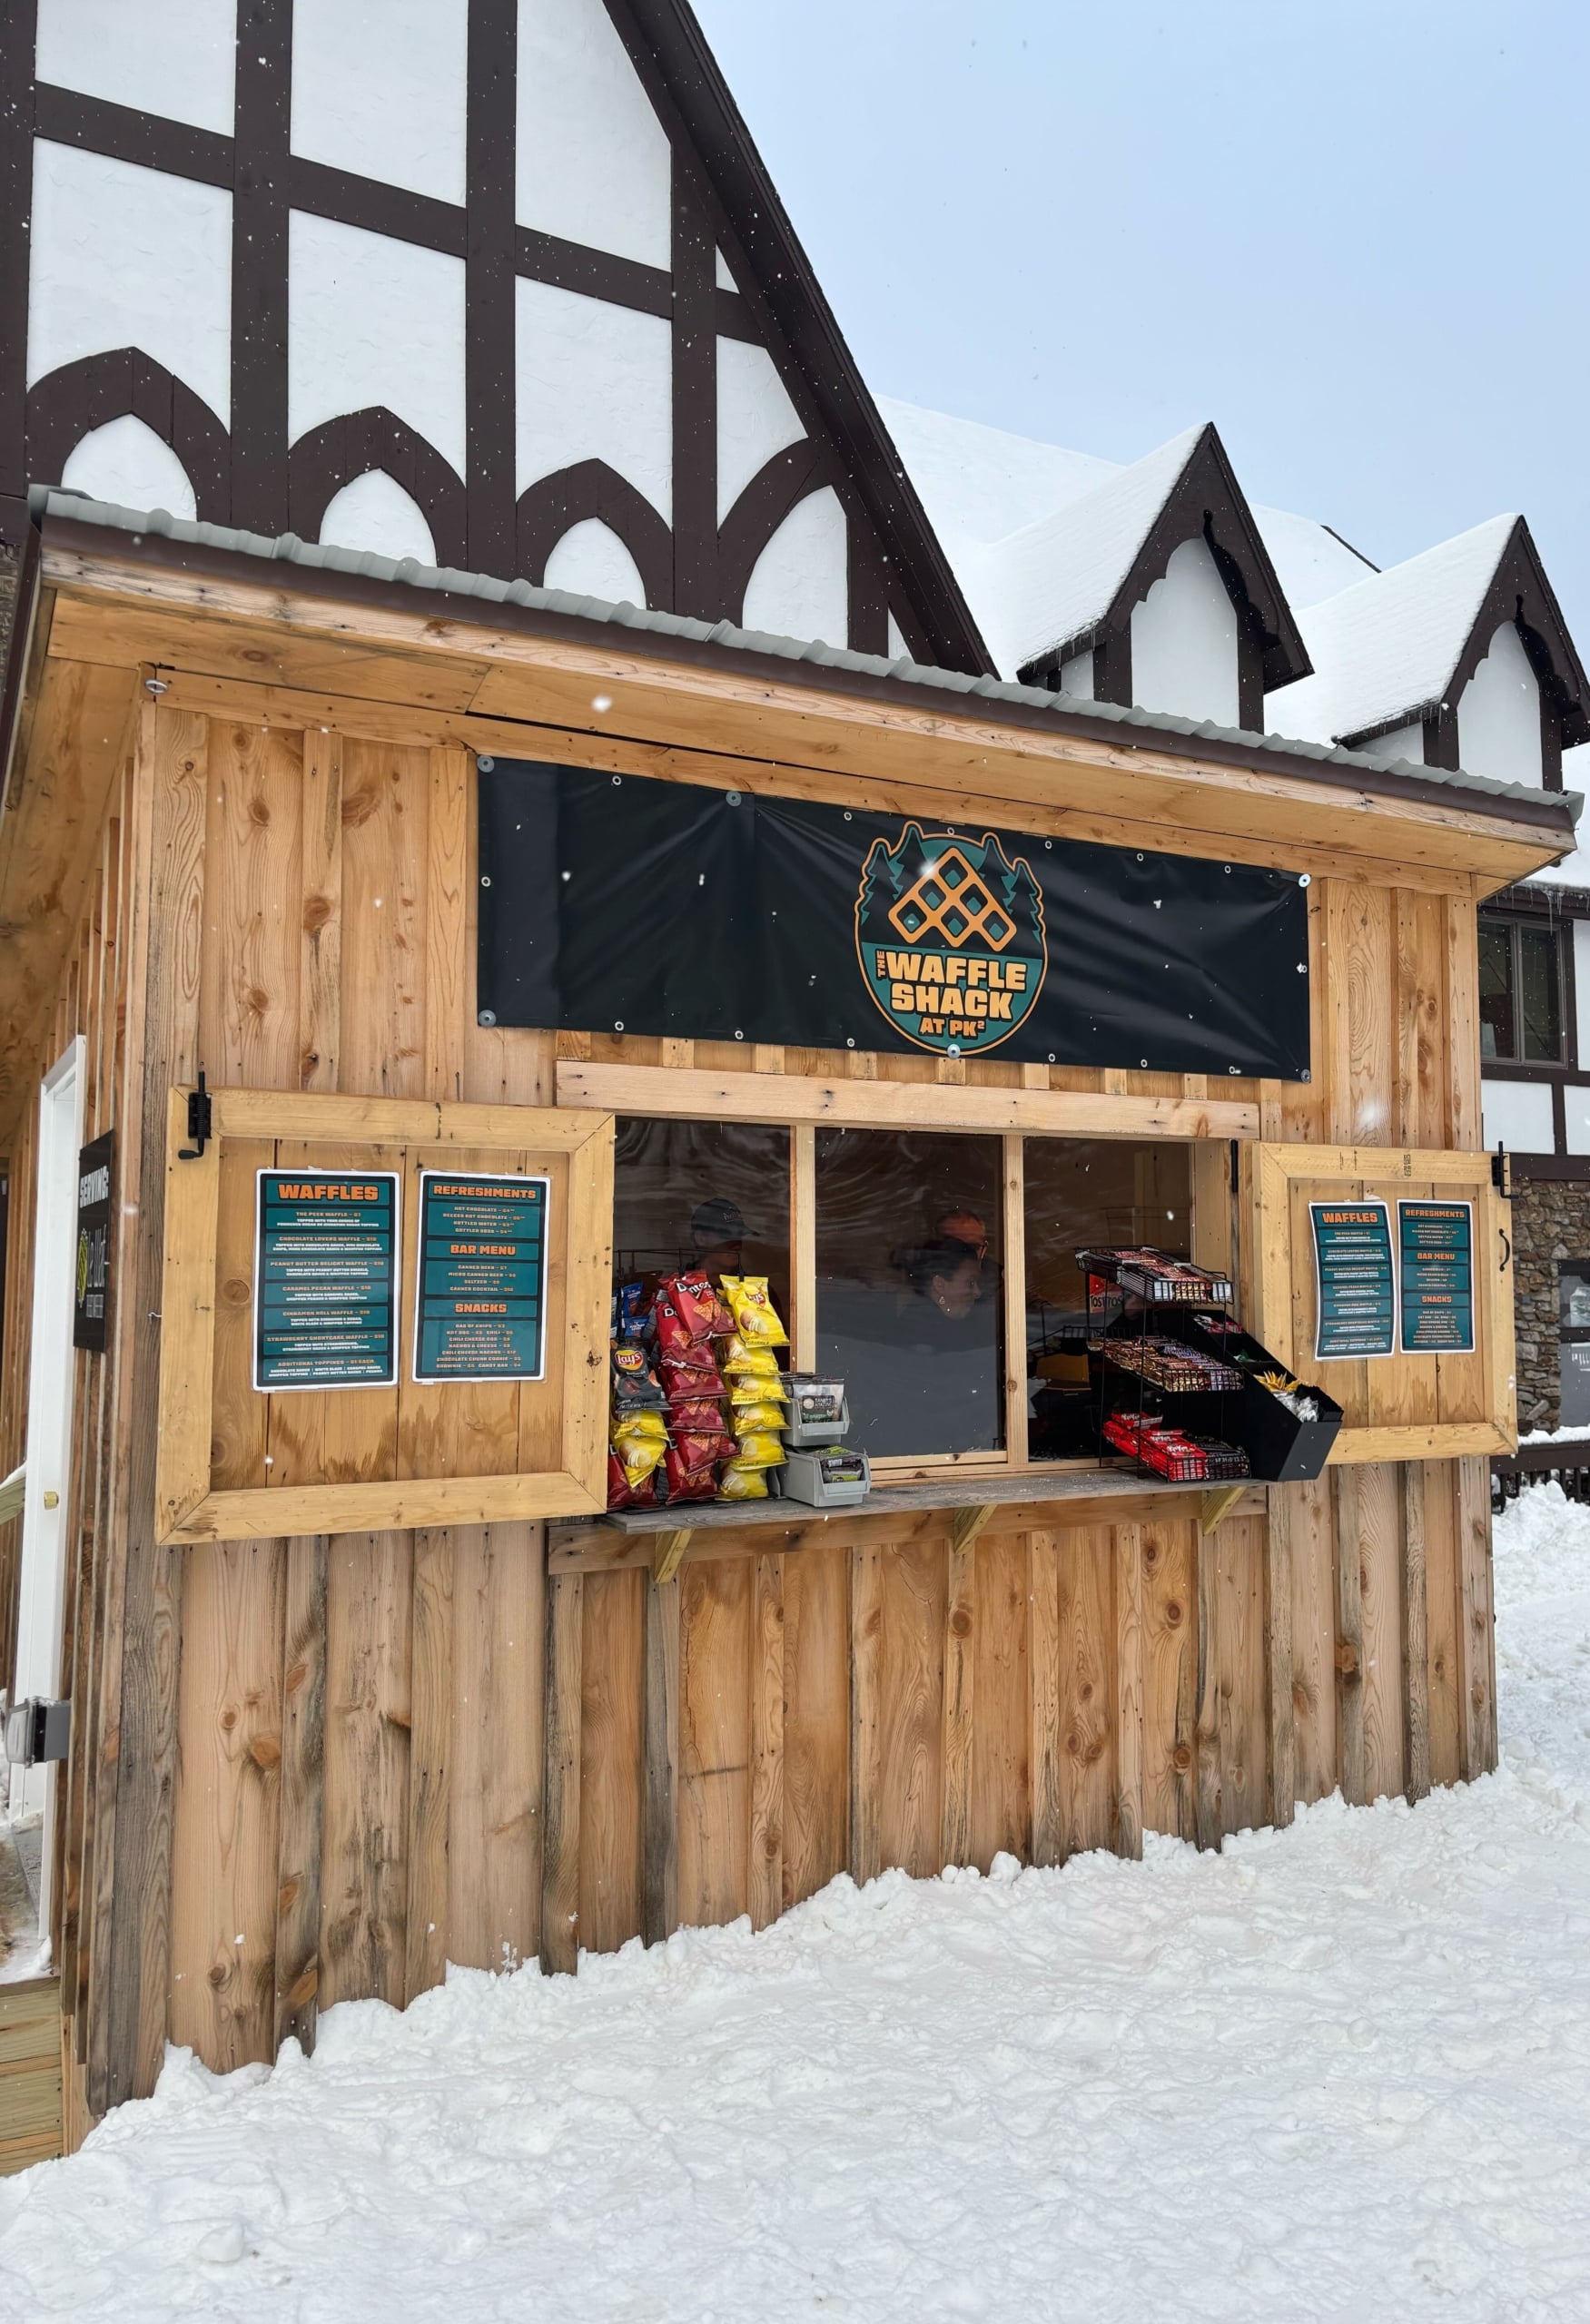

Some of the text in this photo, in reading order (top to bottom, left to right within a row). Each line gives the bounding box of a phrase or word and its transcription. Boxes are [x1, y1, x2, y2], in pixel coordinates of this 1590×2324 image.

[877, 950, 885, 978] THE
[885, 951, 1027, 990] WAFFLE
[892, 982, 1012, 1019] SHACK
[920, 1017, 944, 1034] AT
[277, 1184, 379, 1201] WAFFLES
[433, 1185, 536, 1199] REFRESHMENTS
[1322, 1212, 1378, 1224] WAFFLES
[1405, 1209, 1465, 1218] REFRESHMENTS
[450, 1245, 516, 1256] BAR MENU
[1434, 1252, 1455, 1260] MENU
[1090, 1295, 1123, 1308] TOSTTOS
[1422, 1295, 1452, 1304] SNACKS
[455, 1303, 507, 1314] SNACKS
